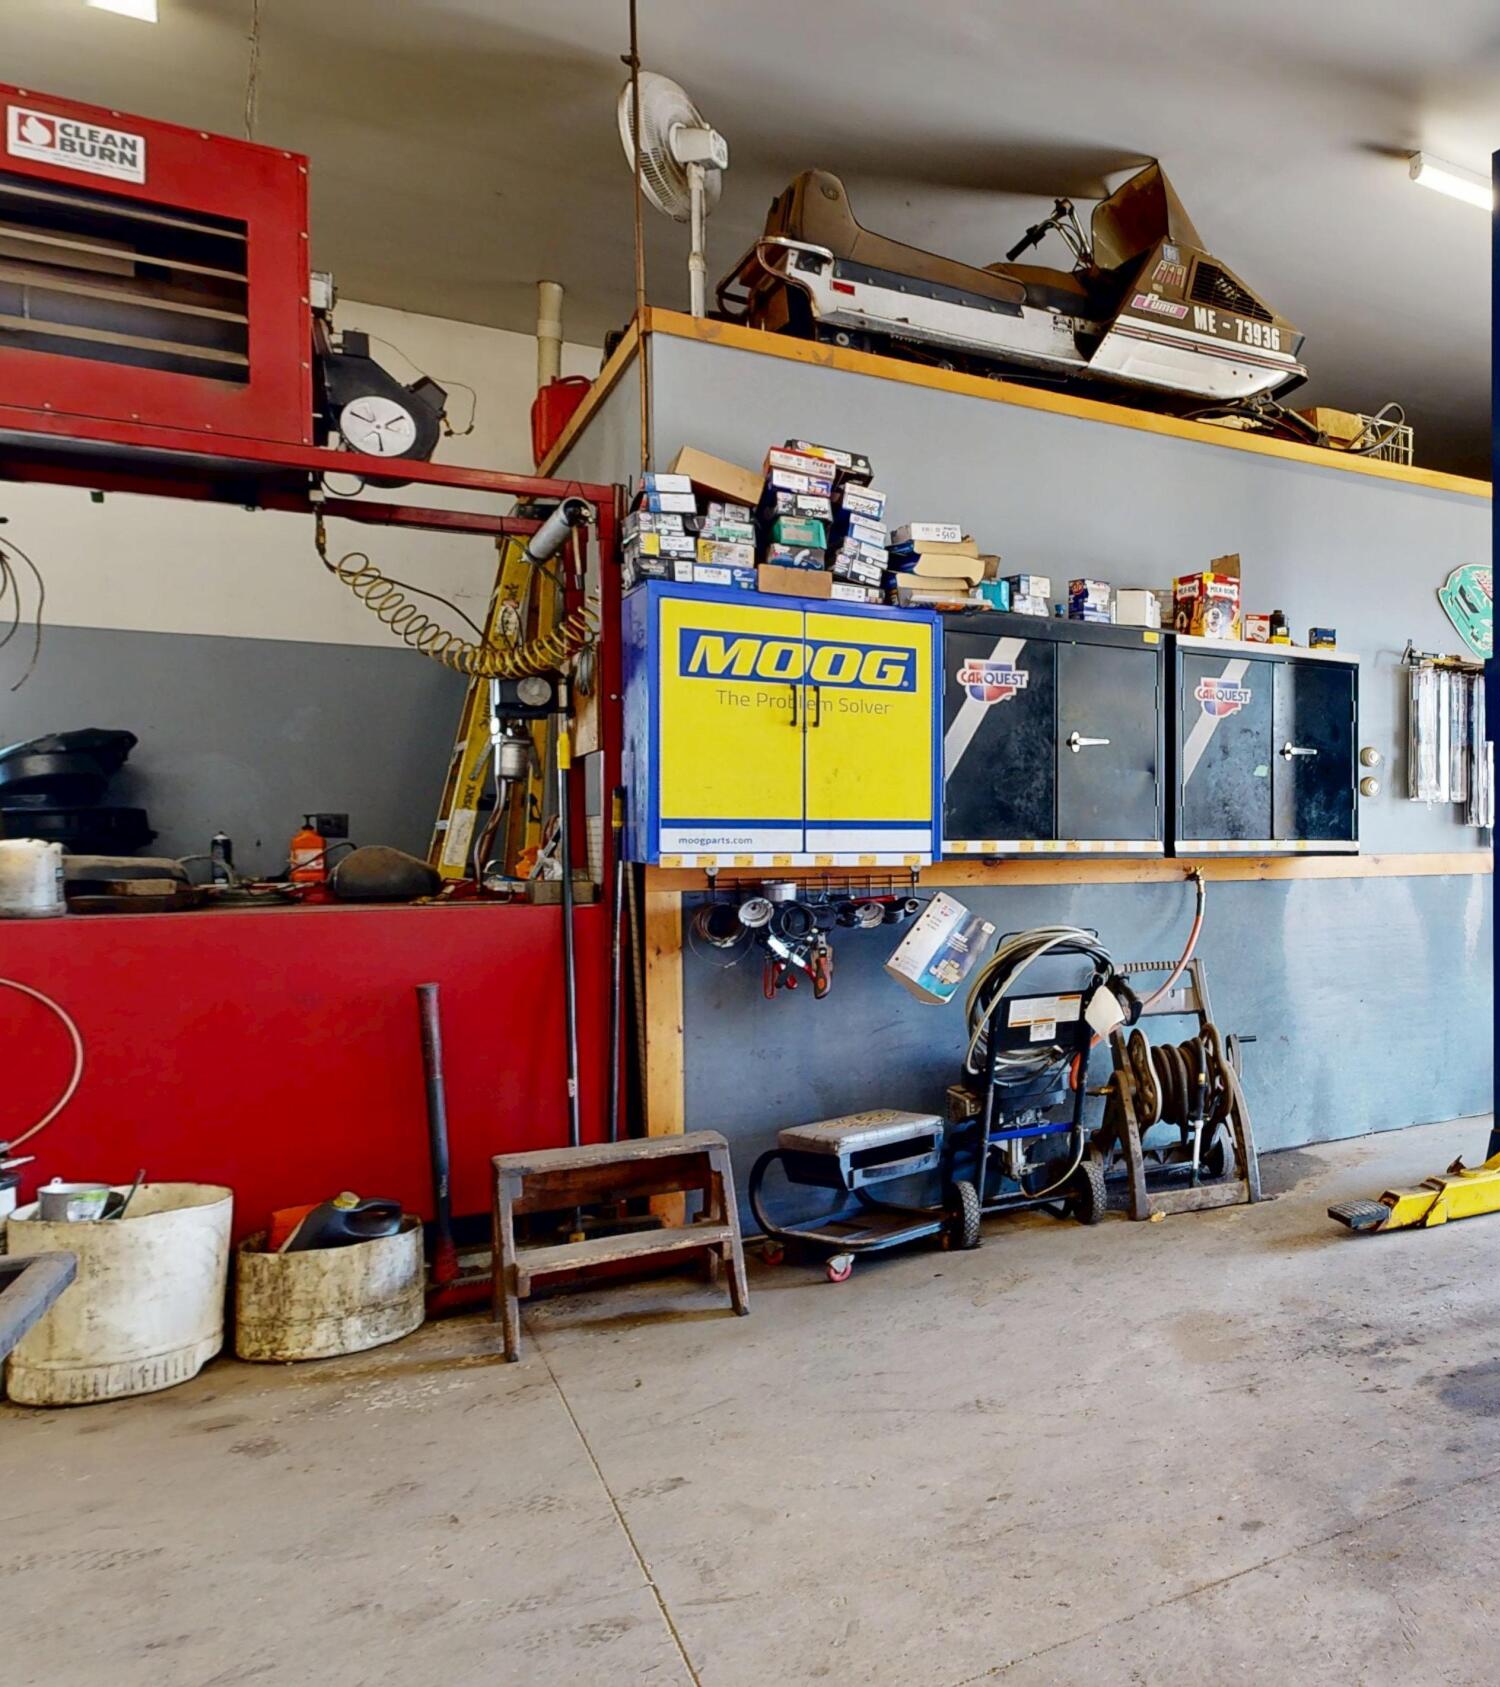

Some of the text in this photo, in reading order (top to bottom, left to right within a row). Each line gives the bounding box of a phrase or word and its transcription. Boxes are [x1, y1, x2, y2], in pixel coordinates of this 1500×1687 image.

[60, 122, 137, 153] CLEAN
[60, 137, 137, 169] BURN
[1193, 305, 1217, 334] ME
[1235, 318, 1281, 351] 73936
[688, 635, 909, 687] MOOG
[961, 670, 1025, 686] CARQUEST
[716, 690, 892, 715] The Problem Solver
[1197, 688, 1249, 702] CARQUEST
[678, 836, 753, 847] moogparts.com
